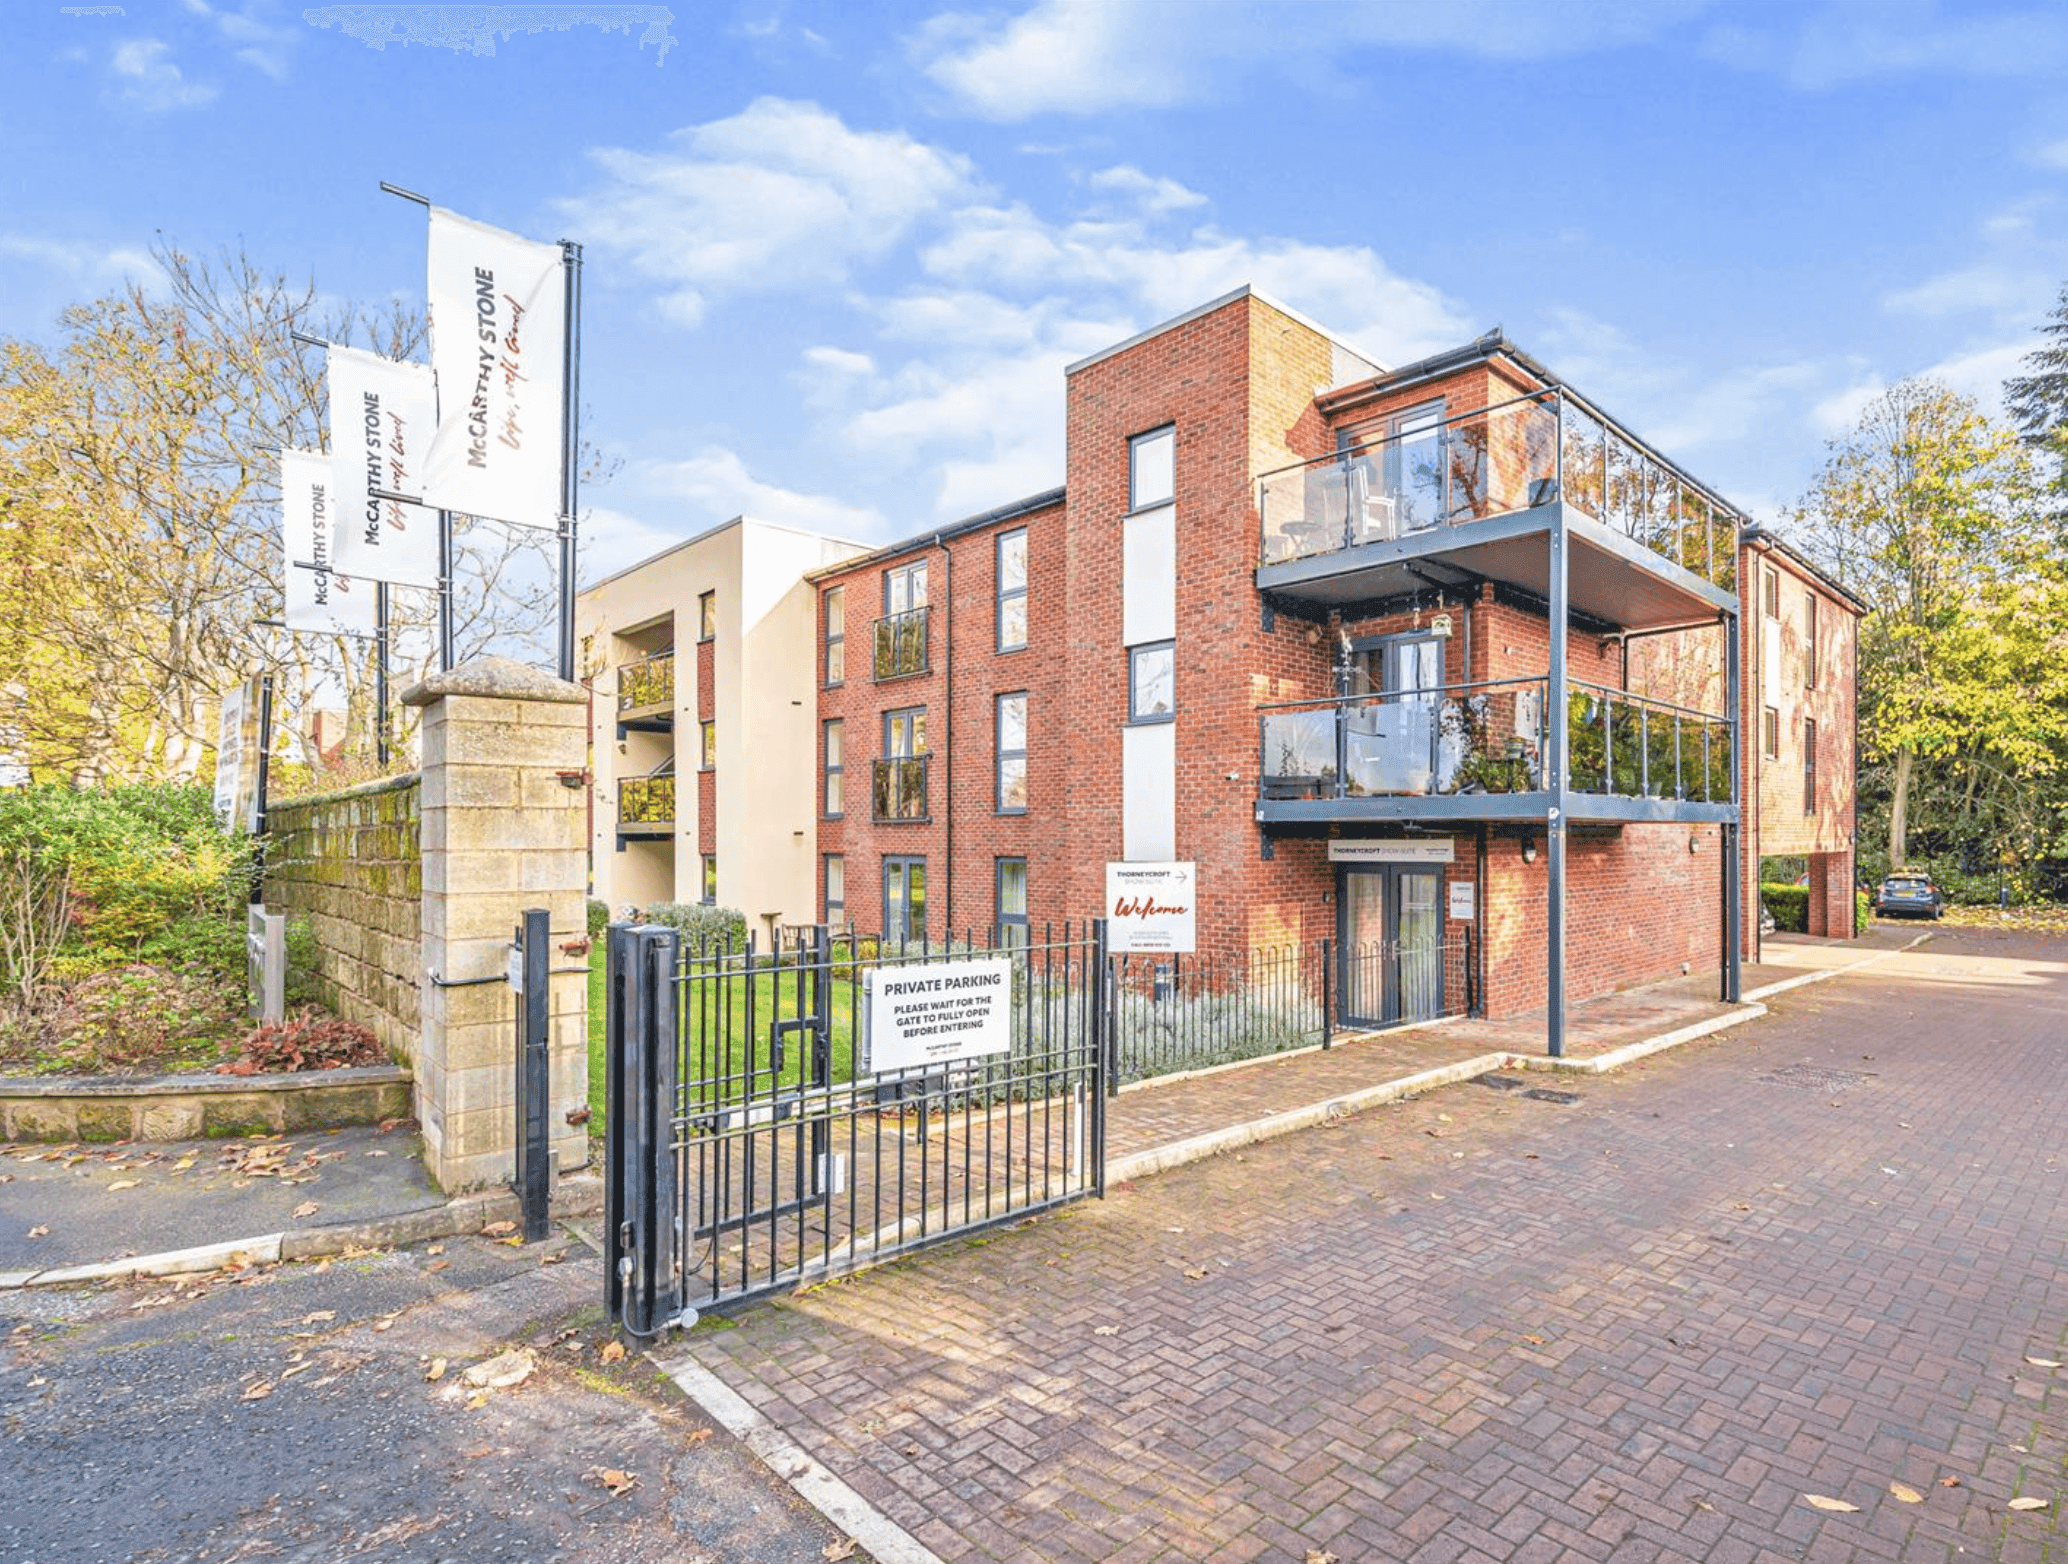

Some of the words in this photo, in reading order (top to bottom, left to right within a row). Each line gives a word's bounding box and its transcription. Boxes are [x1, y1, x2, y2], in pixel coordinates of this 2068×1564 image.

[475, 266, 496, 344] STONE
[364, 391, 381, 448] STONE
[467, 346, 495, 469] McCARTHY
[312, 483, 325, 529] STONE
[364, 451, 381, 546] McCARTHY
[313, 531, 328, 605] McCARTHY
[1114, 896, 1188, 920] Welcome
[884, 979, 942, 996] PRIVATE
[945, 973, 1001, 990] PARKING
[894, 1003, 928, 1014] PLEASE
[930, 1000, 954, 1010] WAIT
[956, 997, 974, 1007] FOR
[975, 995, 992, 1005] THE
[896, 1015, 921, 1027] GATE
[923, 1014, 936, 1023] TO
[938, 1010, 964, 1021] FULLY
[966, 1007, 990, 1018] OPEN
[903, 1025, 938, 1038] BEFORE
[940, 1019, 984, 1033] ENTERING
